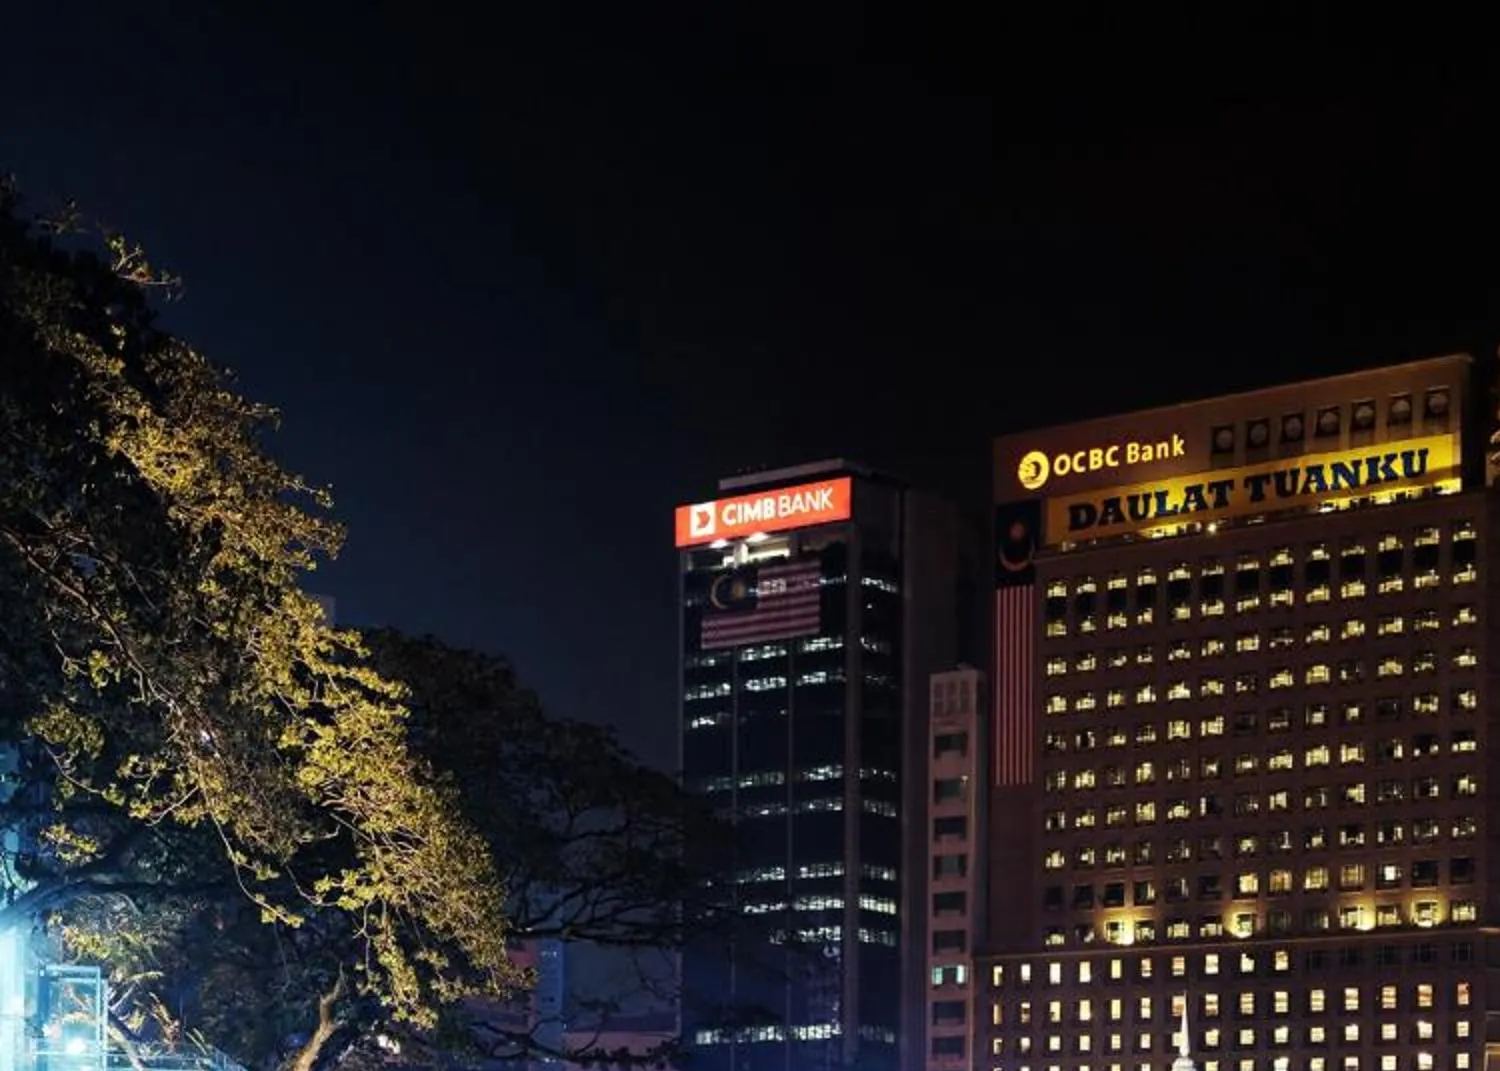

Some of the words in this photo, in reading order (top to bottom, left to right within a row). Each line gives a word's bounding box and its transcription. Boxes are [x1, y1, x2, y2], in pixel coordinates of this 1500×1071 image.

[1053, 444, 1120, 477] OCBC
[1126, 433, 1186, 465] Bank
[1068, 479, 1235, 531] DAULAT
[1243, 447, 1430, 502] TUANKU
